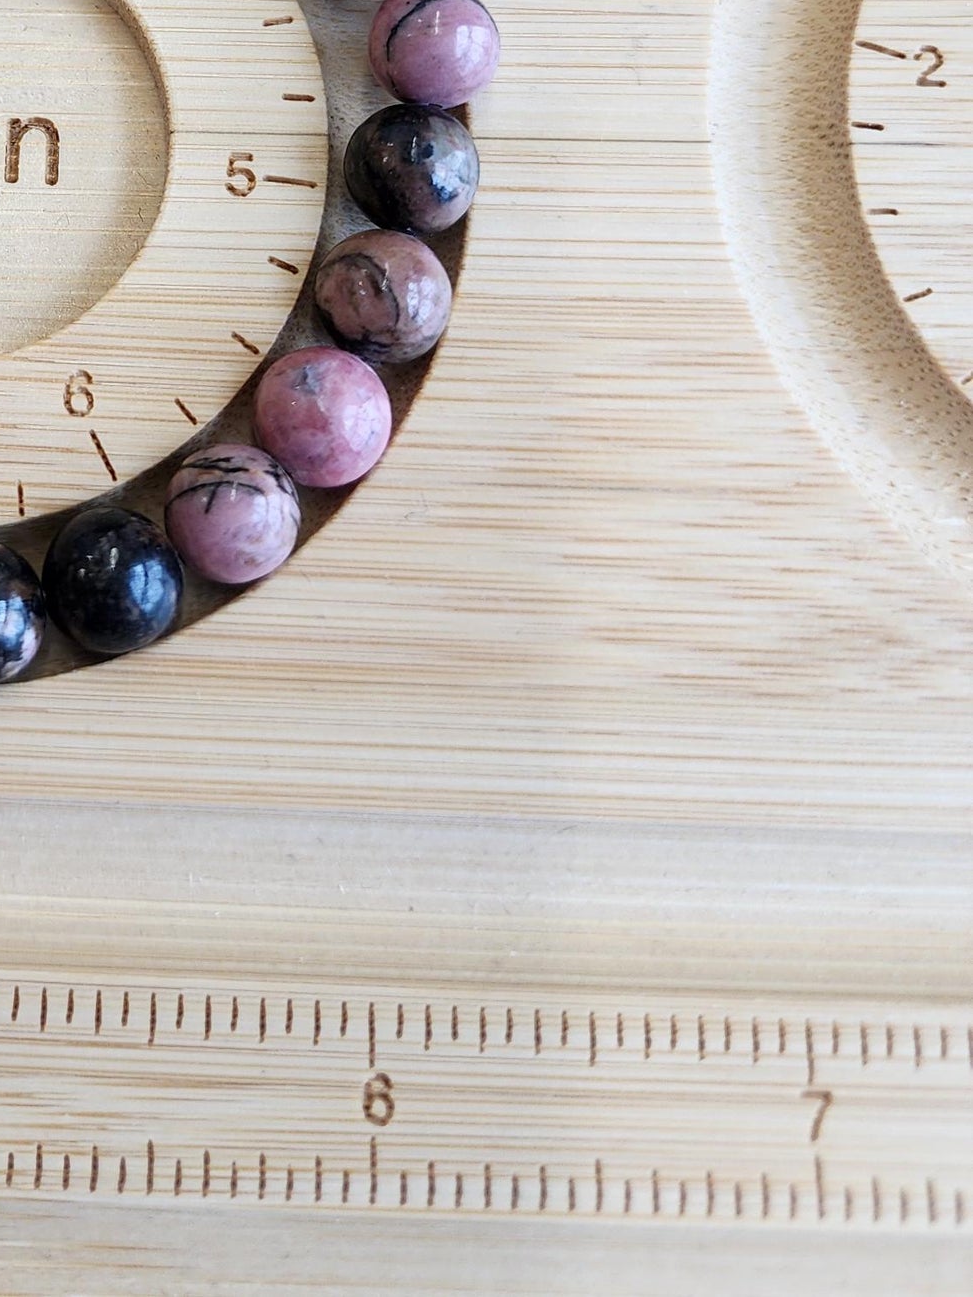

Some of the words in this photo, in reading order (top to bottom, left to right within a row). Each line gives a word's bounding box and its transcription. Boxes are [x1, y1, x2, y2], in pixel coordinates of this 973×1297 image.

[913, 45, 947, 87] 2
[225, 152, 258, 198] 5
[62, 369, 95, 418] 6
[362, 1072, 396, 1128] 6
[801, 1089, 834, 1142] 7
